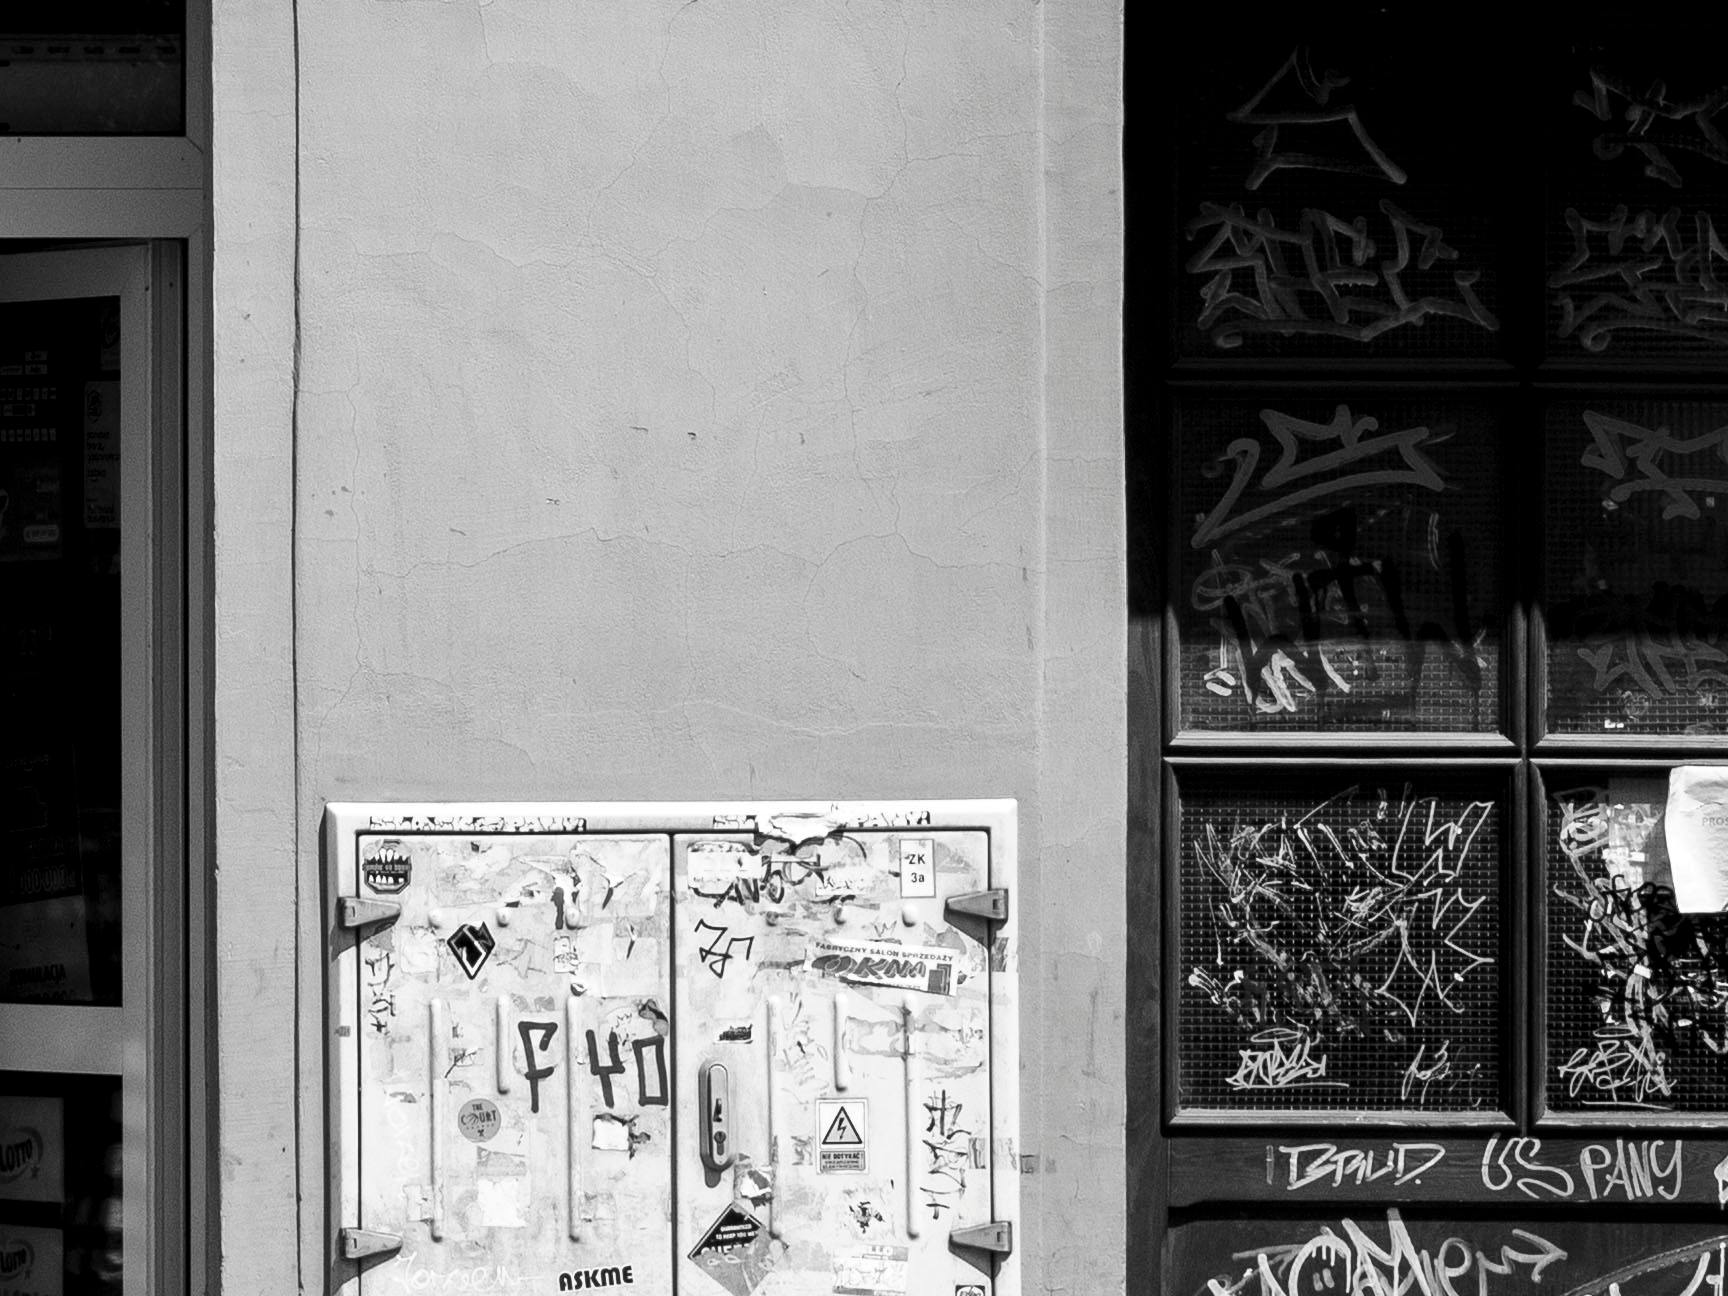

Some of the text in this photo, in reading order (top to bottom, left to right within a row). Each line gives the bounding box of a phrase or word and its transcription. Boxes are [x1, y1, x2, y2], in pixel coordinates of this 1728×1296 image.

[911, 872, 925, 883] 3a
[815, 942, 867, 954] FABRYCZNY
[870, 948, 899, 958] SALON
[813, 954, 927, 980] OKNA
[559, 1265, 634, 1292] ASKME
